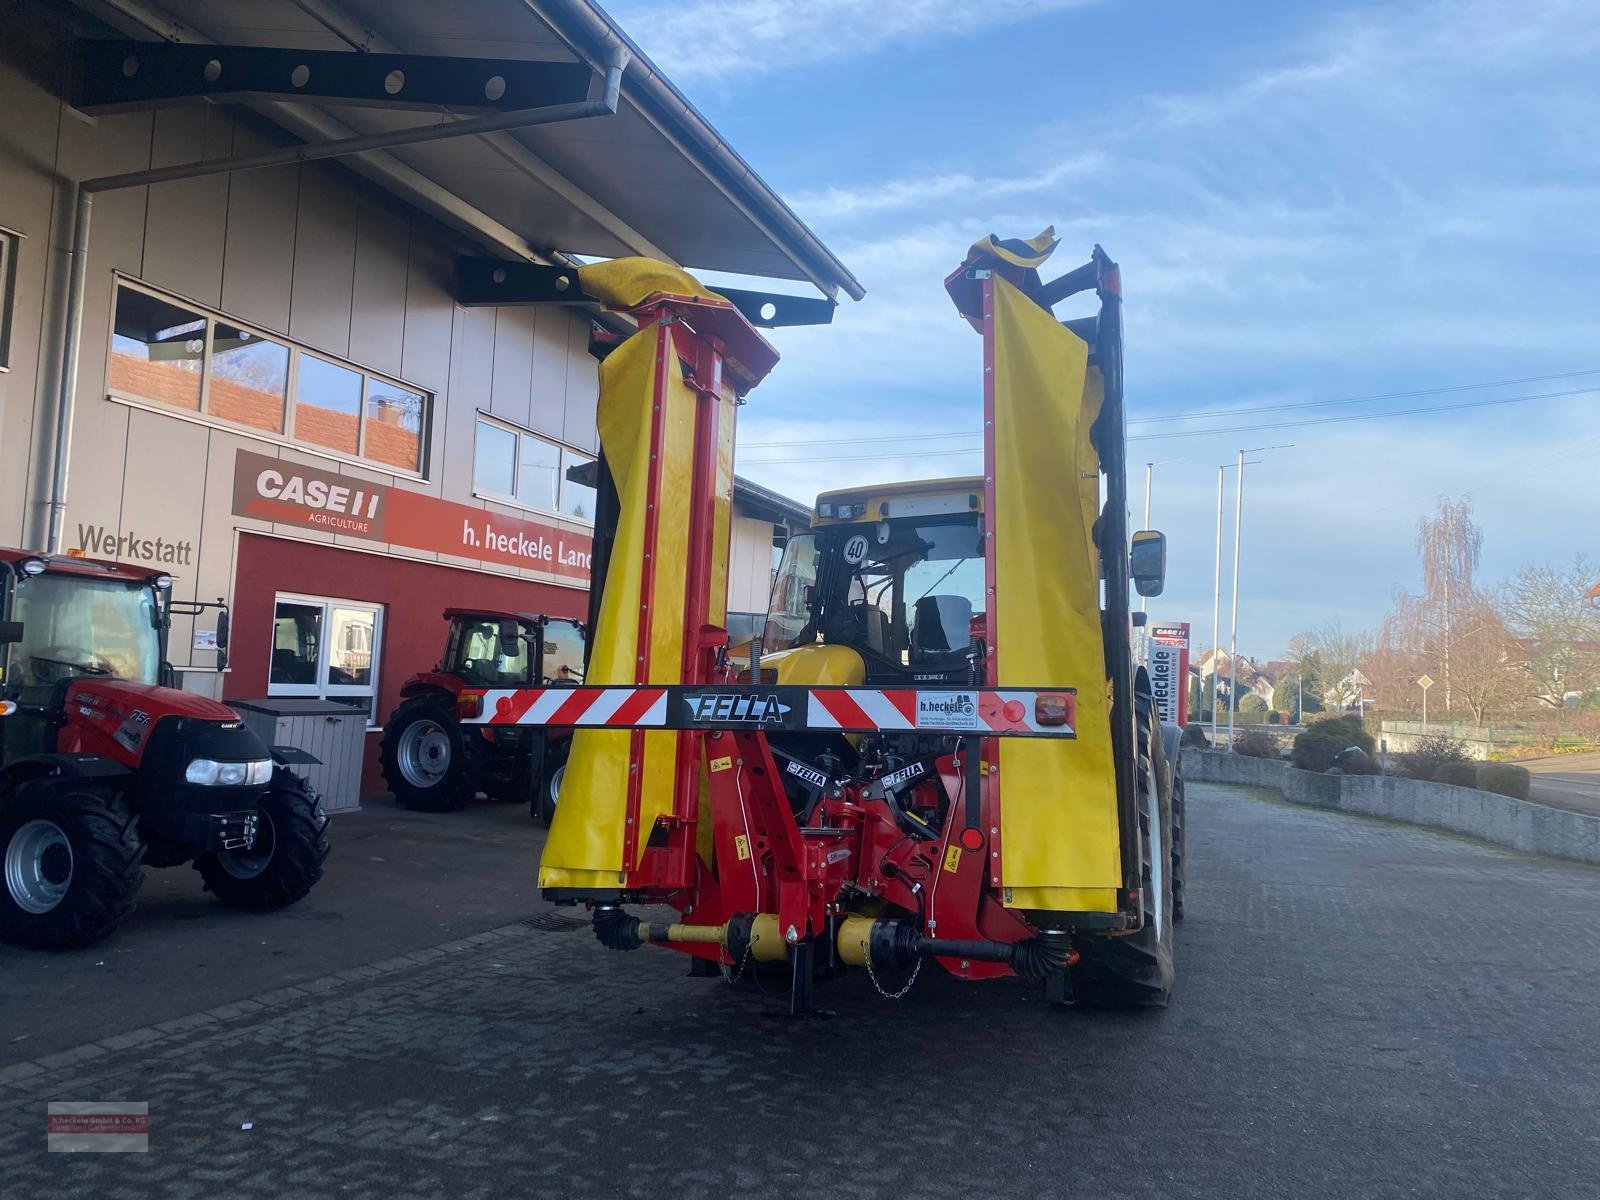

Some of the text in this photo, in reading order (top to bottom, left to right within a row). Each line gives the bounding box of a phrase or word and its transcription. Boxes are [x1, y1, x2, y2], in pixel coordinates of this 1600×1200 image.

[256, 469, 350, 513] CASE
[308, 513, 368, 533] AGRICULTURE
[78, 523, 192, 566] Werkstatt
[463, 519, 480, 547] h.
[485, 524, 553, 561] heckele
[848, 541, 863, 558] 40
[1155, 639, 1185, 647] STEYR
[694, 694, 783, 722] FELLA
[920, 700, 963, 712] h.heckele
[798, 765, 826, 787] FELLA
[893, 764, 923, 784] FELLA
